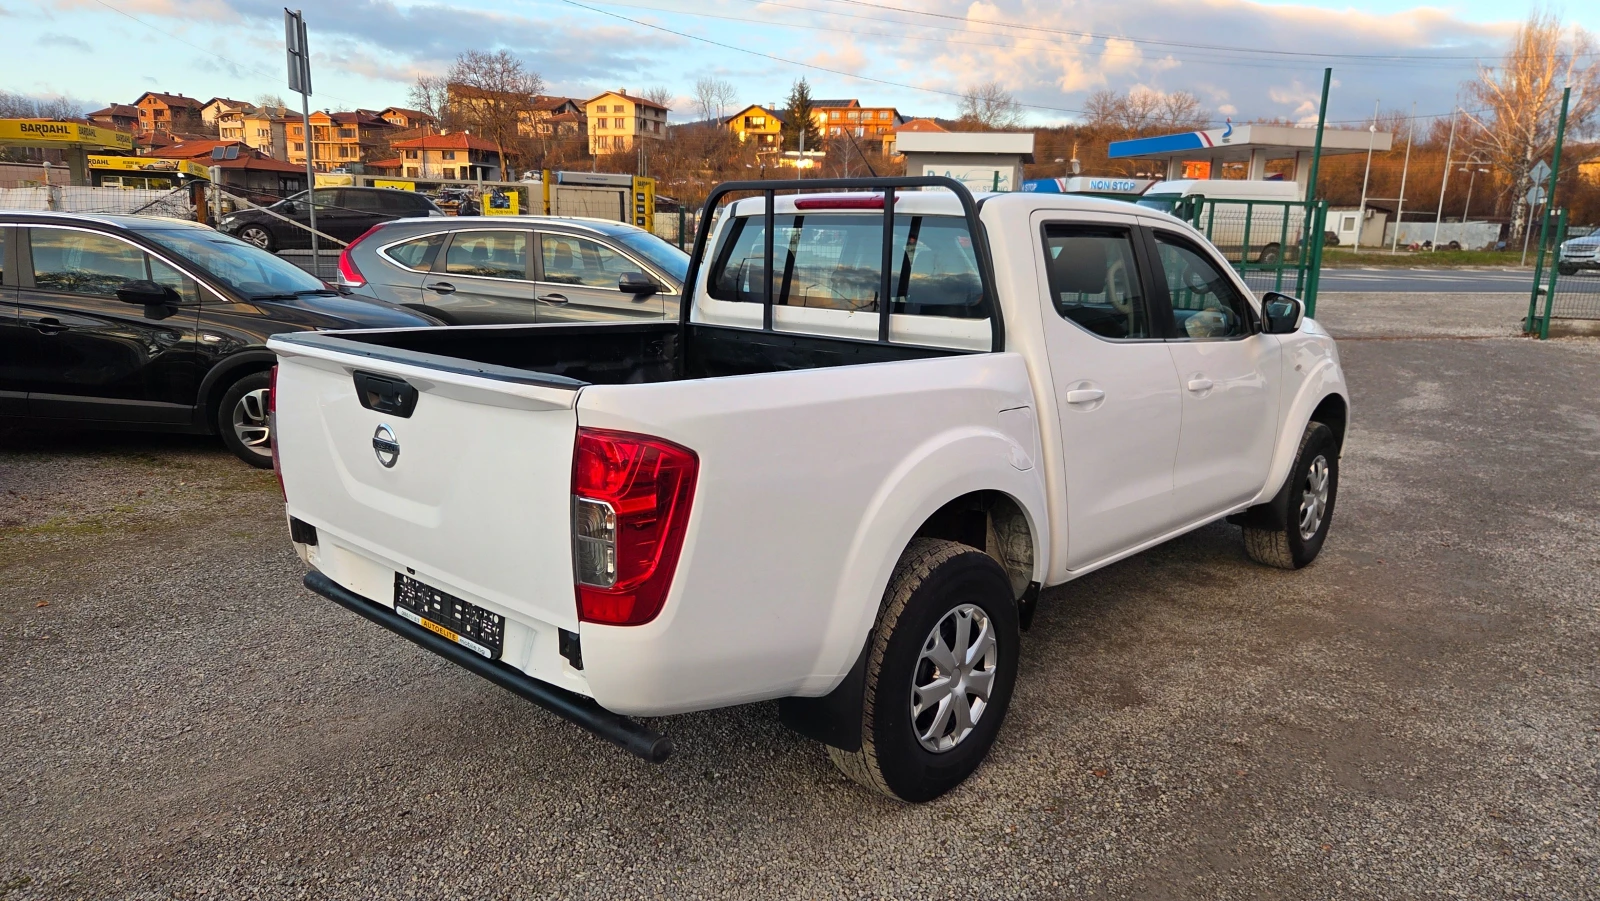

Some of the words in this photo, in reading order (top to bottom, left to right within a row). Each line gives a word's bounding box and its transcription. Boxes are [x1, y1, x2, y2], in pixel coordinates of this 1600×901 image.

[20, 123, 71, 137] BARDAHL
[78, 126, 97, 139] BARDAHL
[87, 158, 110, 167] RDAHL
[1090, 180, 1110, 190] NON
[1112, 181, 1136, 191] STOP
[423, 620, 456, 641] AUTOELITE
